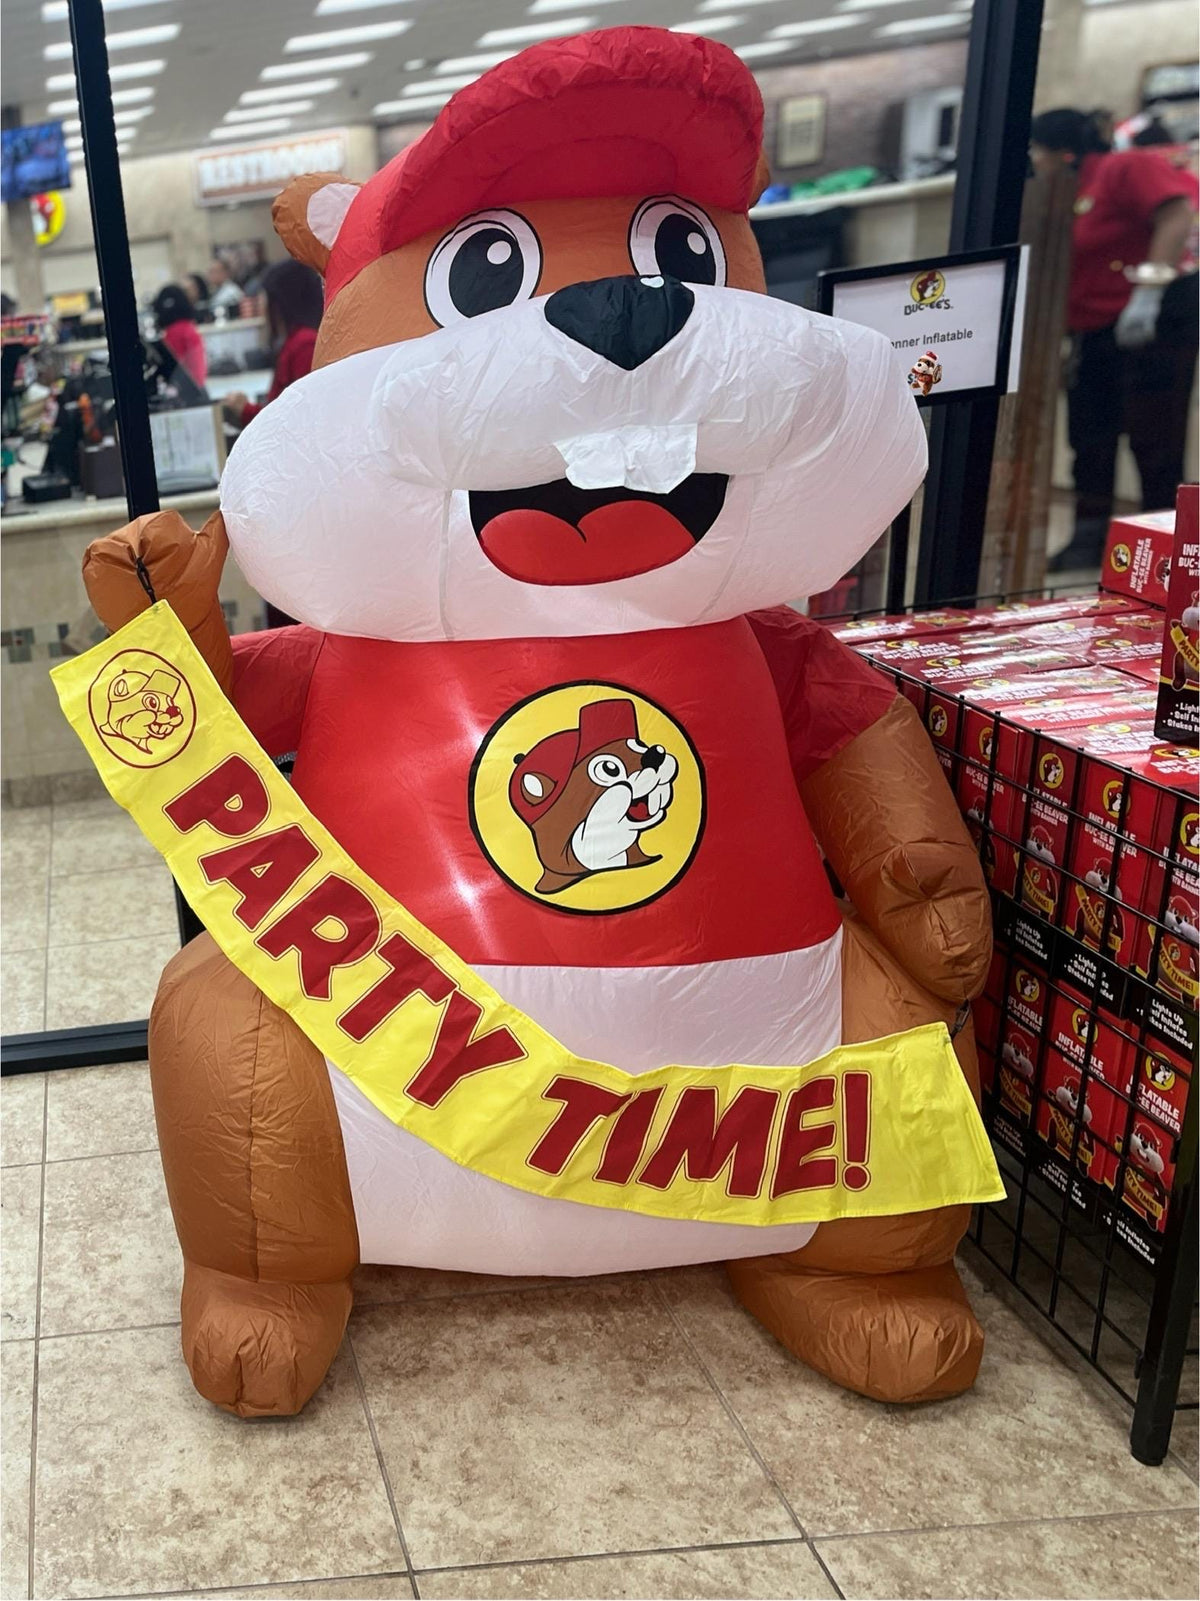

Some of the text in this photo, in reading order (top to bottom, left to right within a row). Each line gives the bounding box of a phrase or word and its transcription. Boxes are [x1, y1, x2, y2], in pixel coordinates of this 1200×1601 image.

[922, 328, 973, 346] Inflatable
[1129, 538, 1145, 590] INFLATABLE
[1044, 804, 1069, 825] BEAVER
[162, 752, 873, 1201] PARTY TIME!
[1170, 968, 1194, 992] TIME!
[1152, 998, 1185, 1027] Lights Up
[1129, 1074, 1180, 1120] IFLATABLE
[1150, 1104, 1181, 1133] BEAVER
